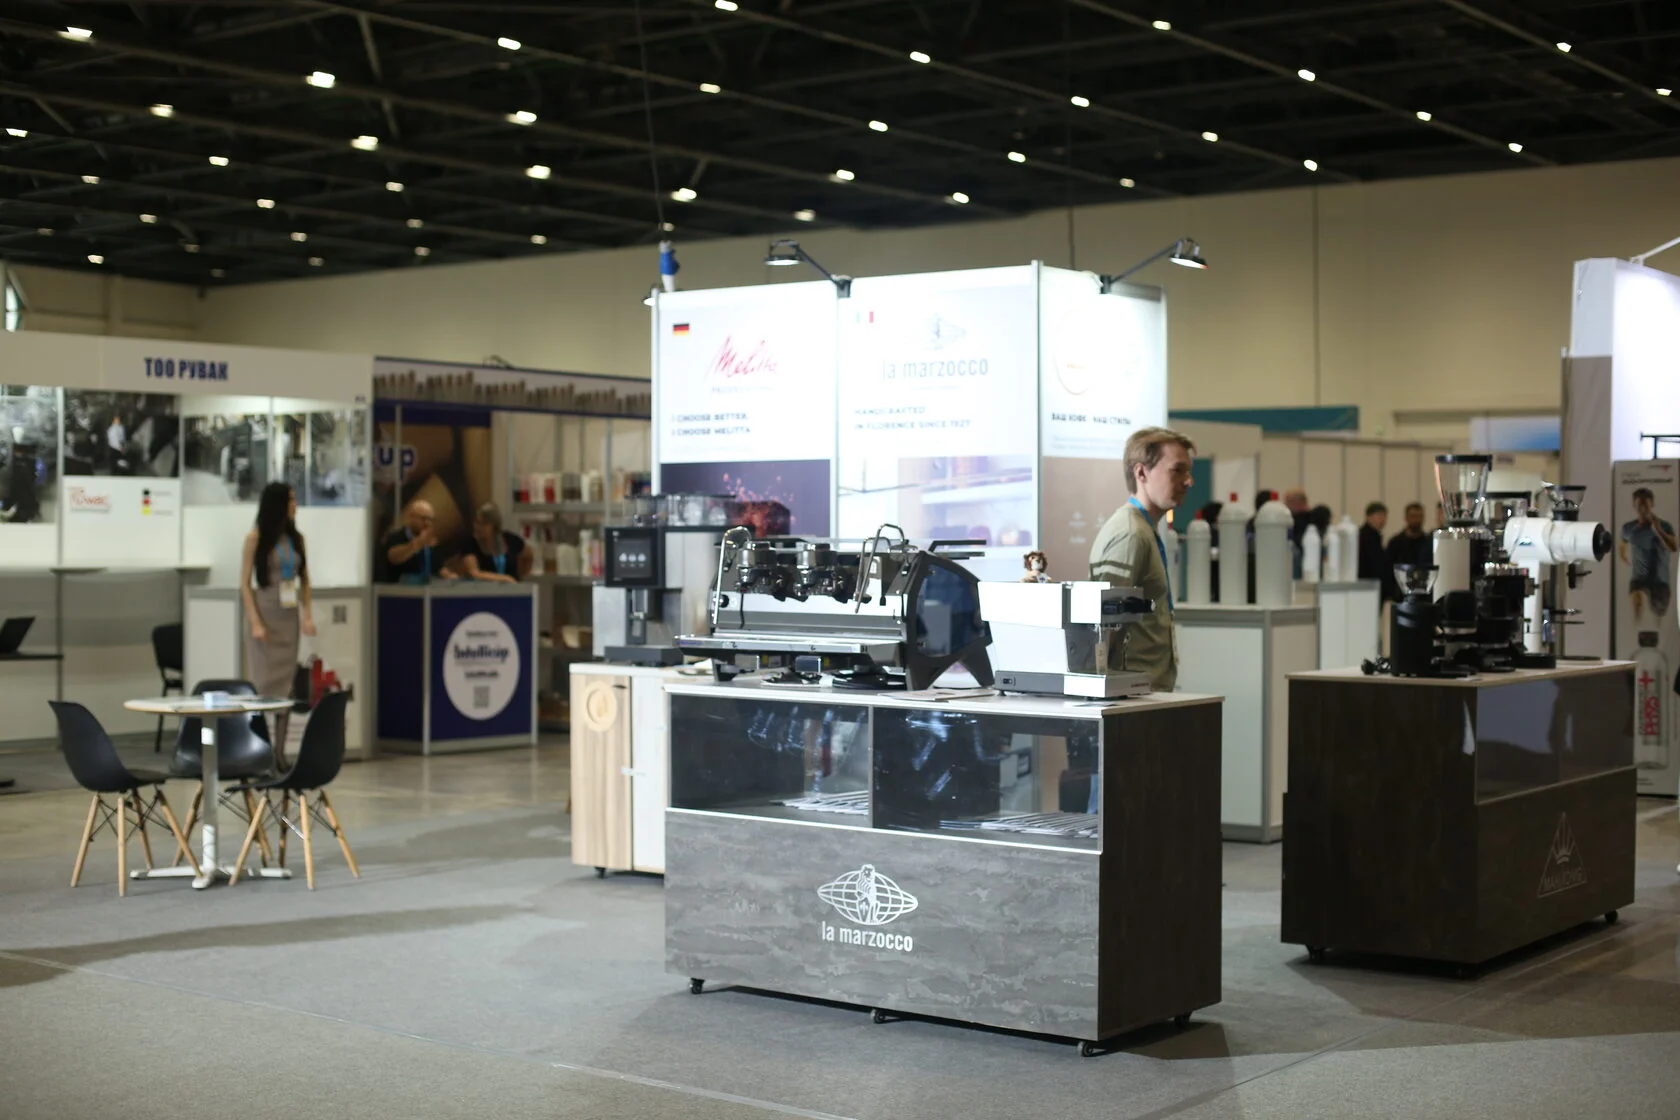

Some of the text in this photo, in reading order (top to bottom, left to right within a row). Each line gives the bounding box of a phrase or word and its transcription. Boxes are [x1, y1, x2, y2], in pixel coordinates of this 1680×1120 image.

[882, 358, 989, 381] la marzocco
[677, 413, 711, 423] CHOOSE
[866, 420, 915, 430] FLORENCE
[919, 420, 947, 429] SINCE
[677, 426, 711, 437] CHOOSE
[821, 920, 914, 952] la marzocco
